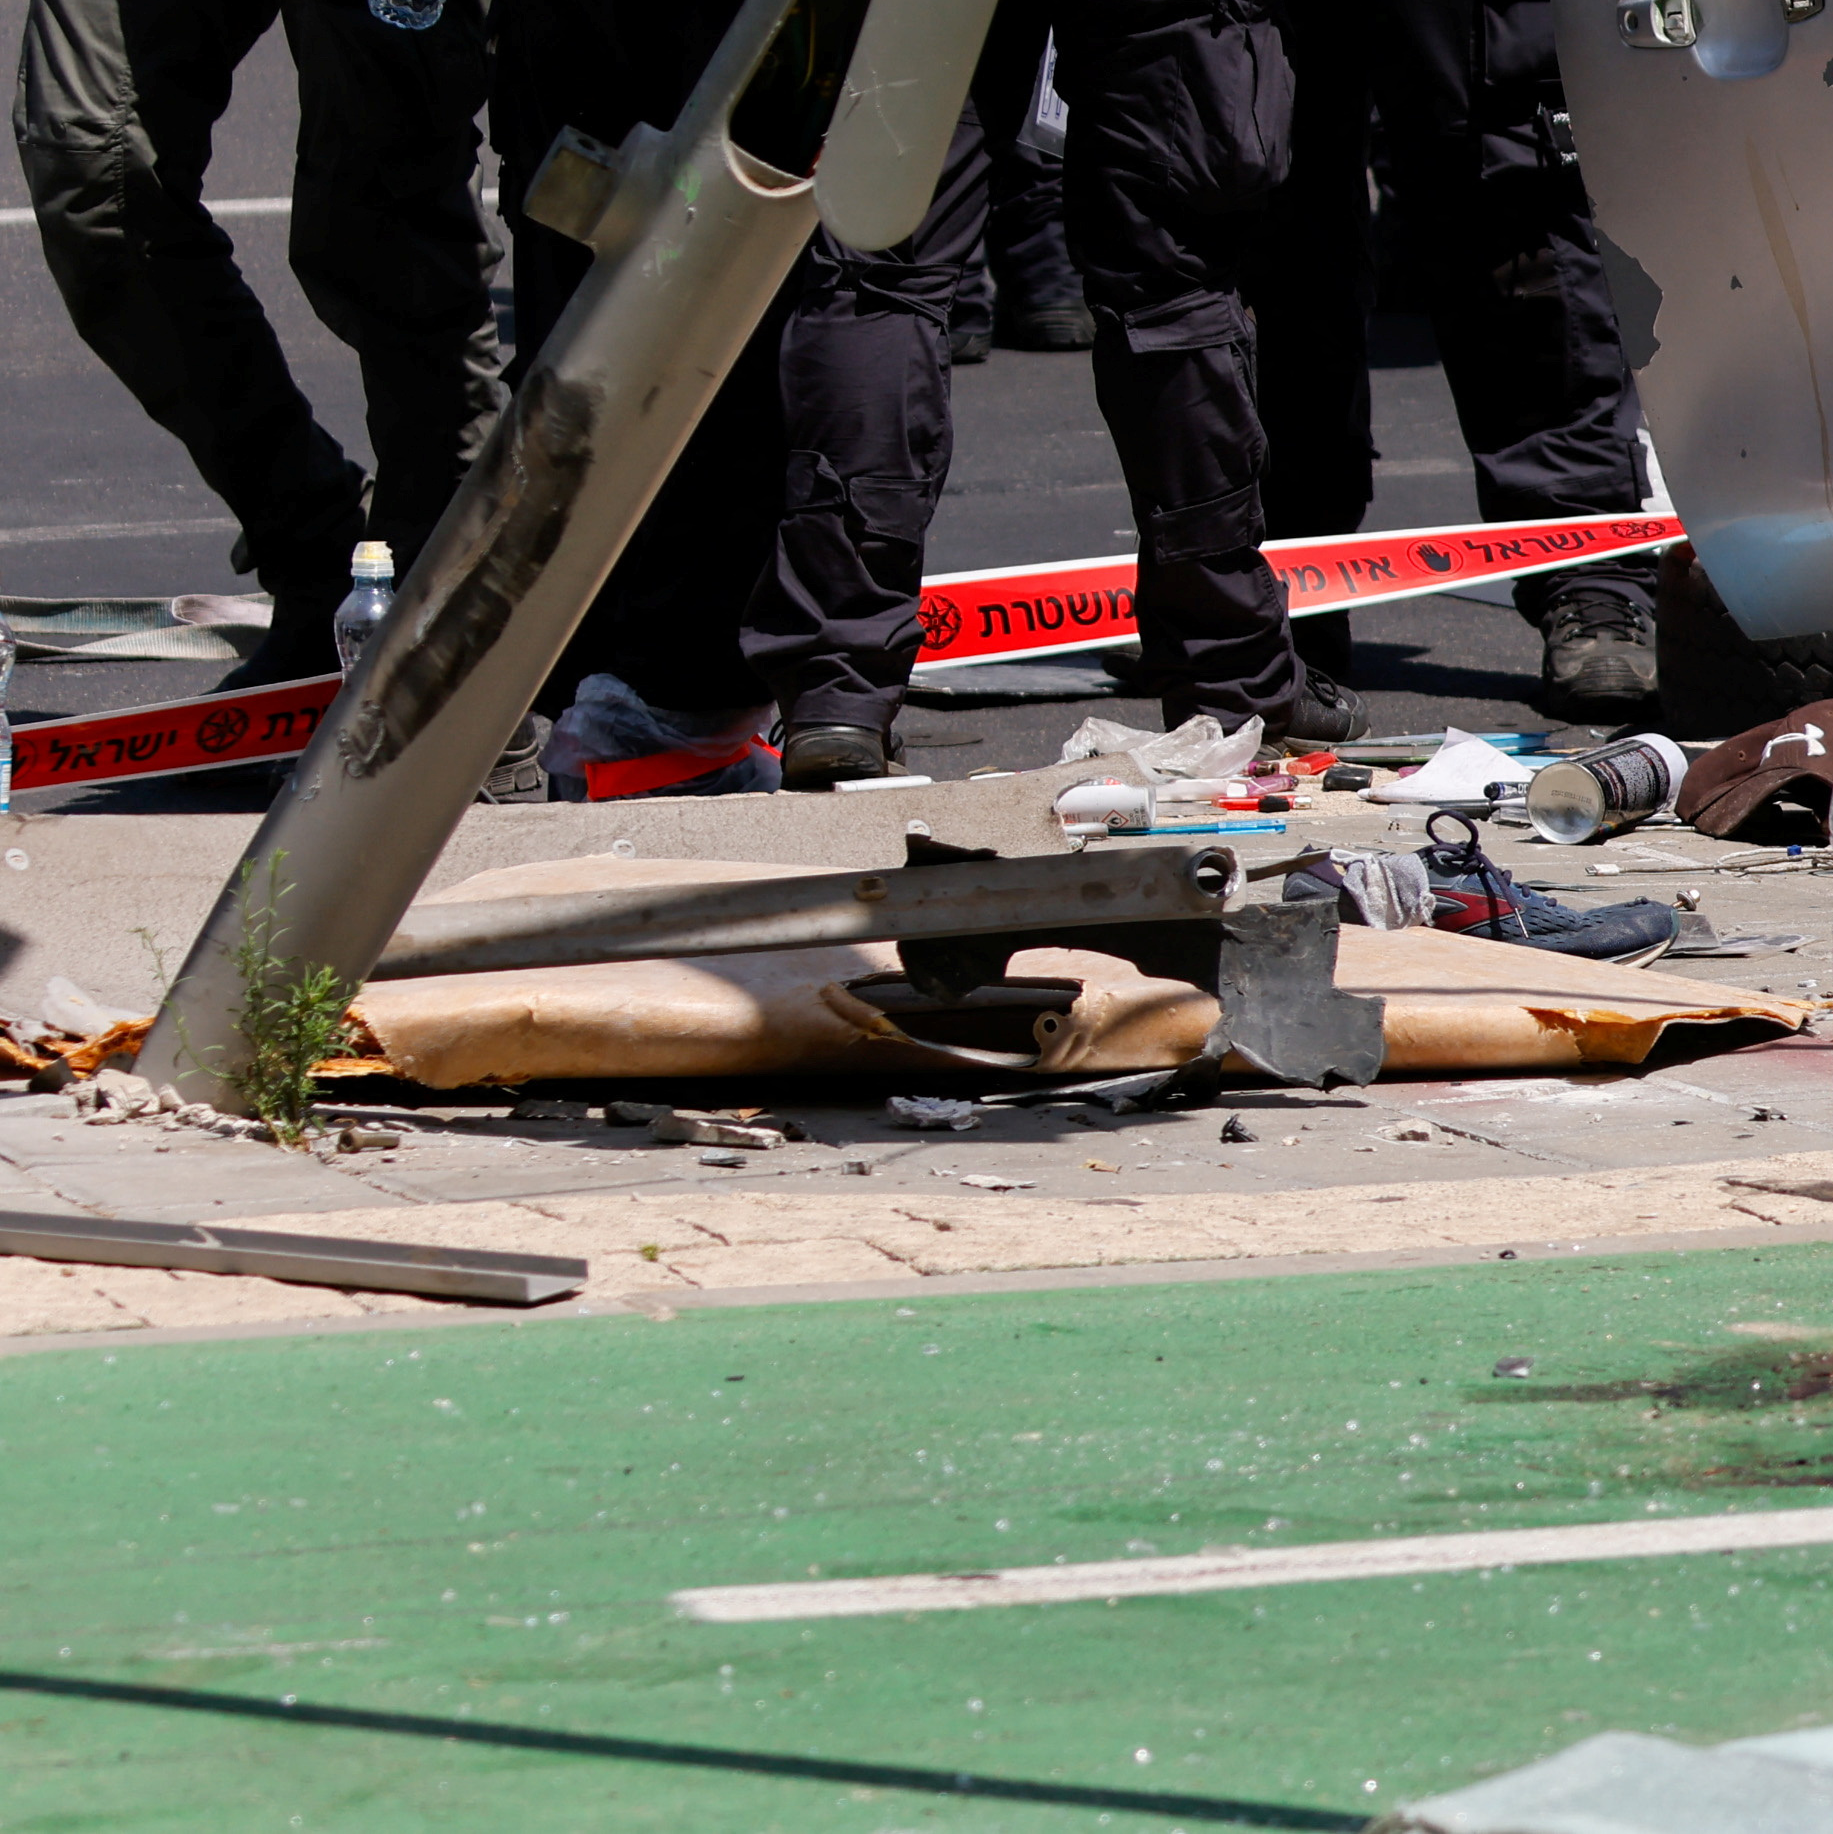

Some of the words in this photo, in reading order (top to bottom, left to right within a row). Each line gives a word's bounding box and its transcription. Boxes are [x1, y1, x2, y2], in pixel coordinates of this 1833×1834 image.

[1462, 528, 1597, 566] ישראל
[1337, 556, 1401, 595] אין
[977, 585, 1136, 636] משטרת
[50, 729, 178, 773] ישראל
